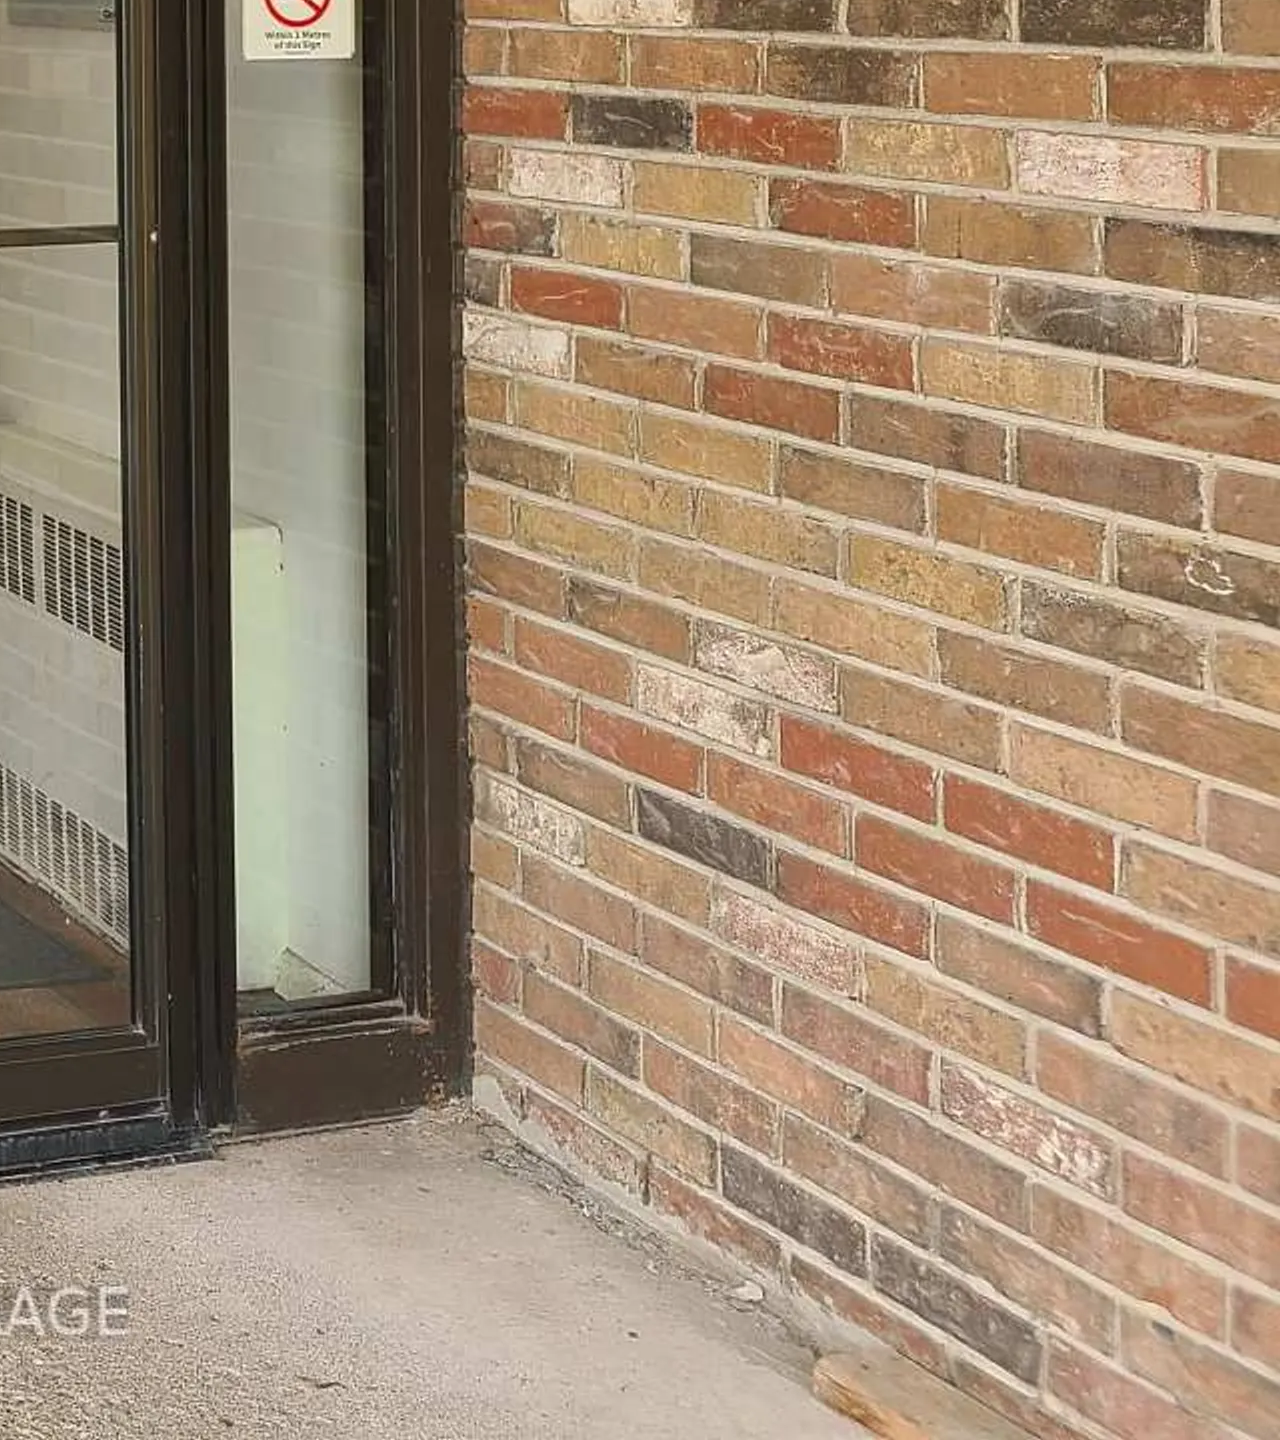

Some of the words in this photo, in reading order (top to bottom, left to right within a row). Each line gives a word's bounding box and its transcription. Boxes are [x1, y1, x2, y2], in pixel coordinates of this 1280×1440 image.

[265, 31, 293, 40] Within
[274, 41, 283, 49] of
[285, 41, 301, 49] this
